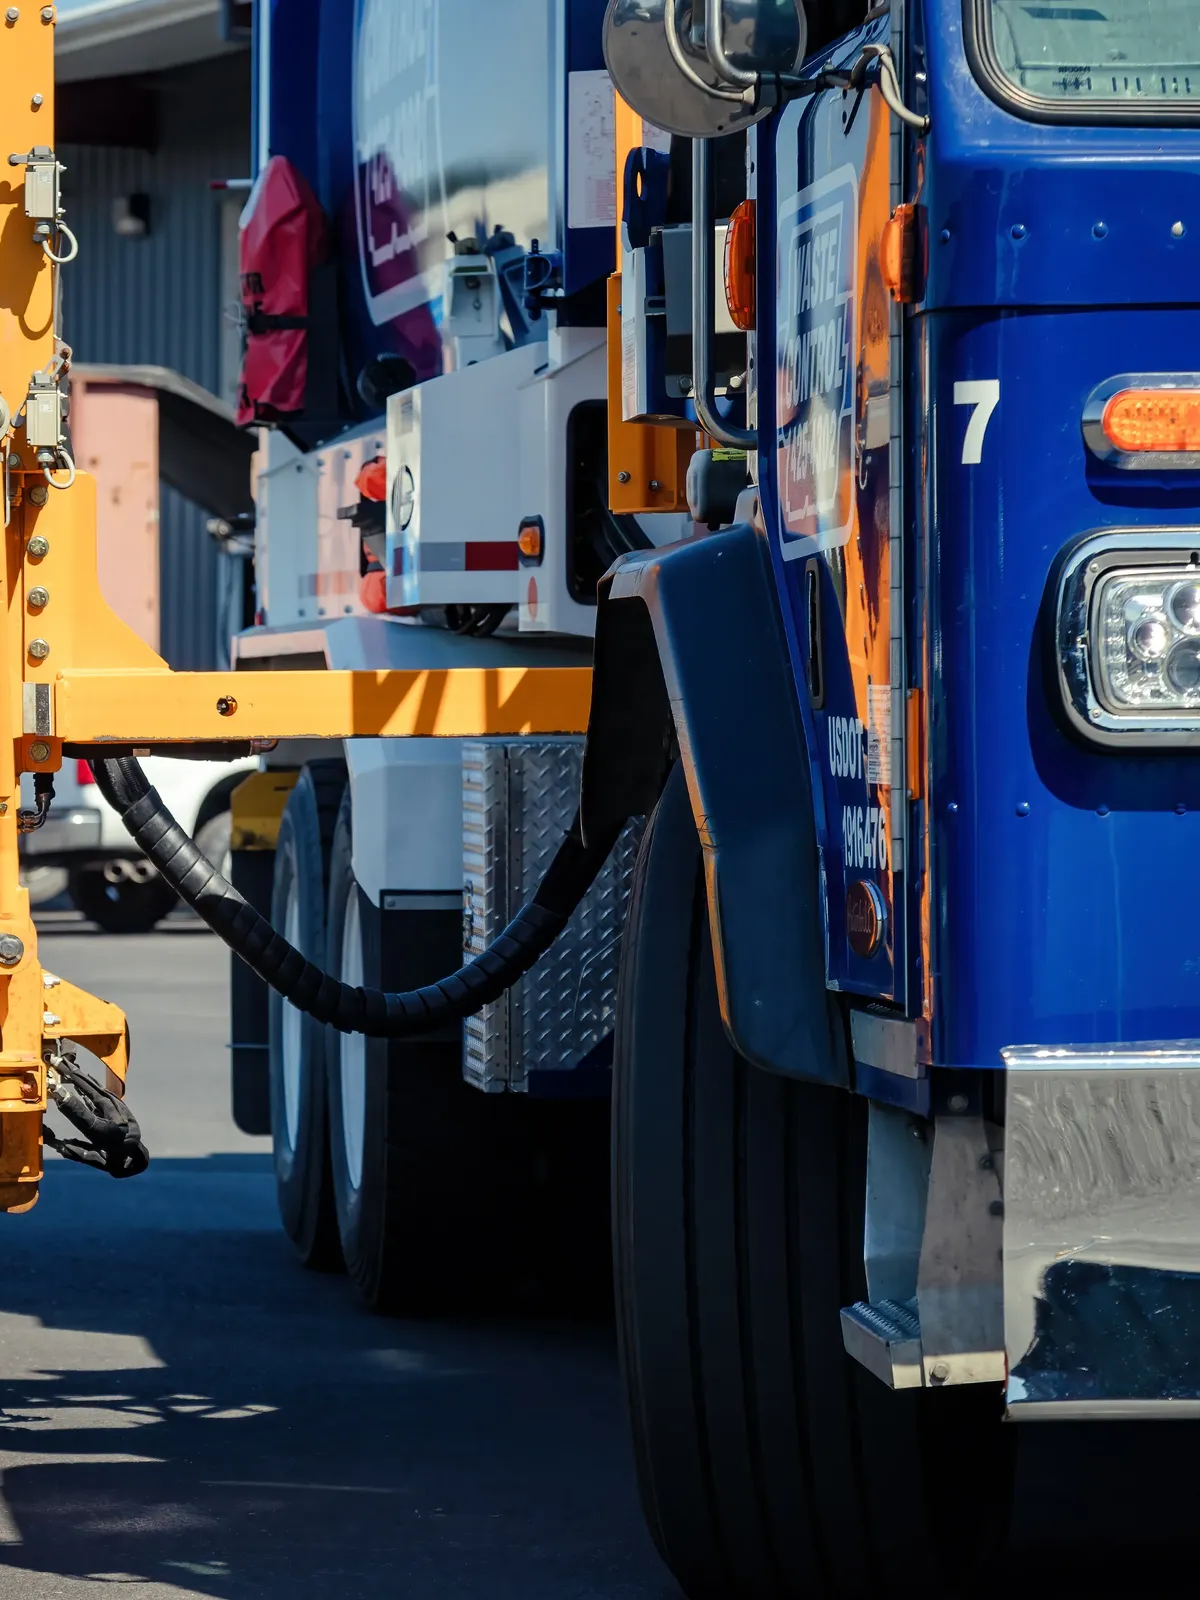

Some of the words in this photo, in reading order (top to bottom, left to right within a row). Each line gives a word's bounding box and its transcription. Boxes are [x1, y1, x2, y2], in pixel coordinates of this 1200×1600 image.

[793, 228, 838, 316] WASTE
[785, 316, 843, 409] CONTROL
[789, 408, 837, 482] 425-4302
[953, 379, 1000, 465] 7
[828, 716, 864, 779] USDOT
[842, 805, 888, 871] 1916476
